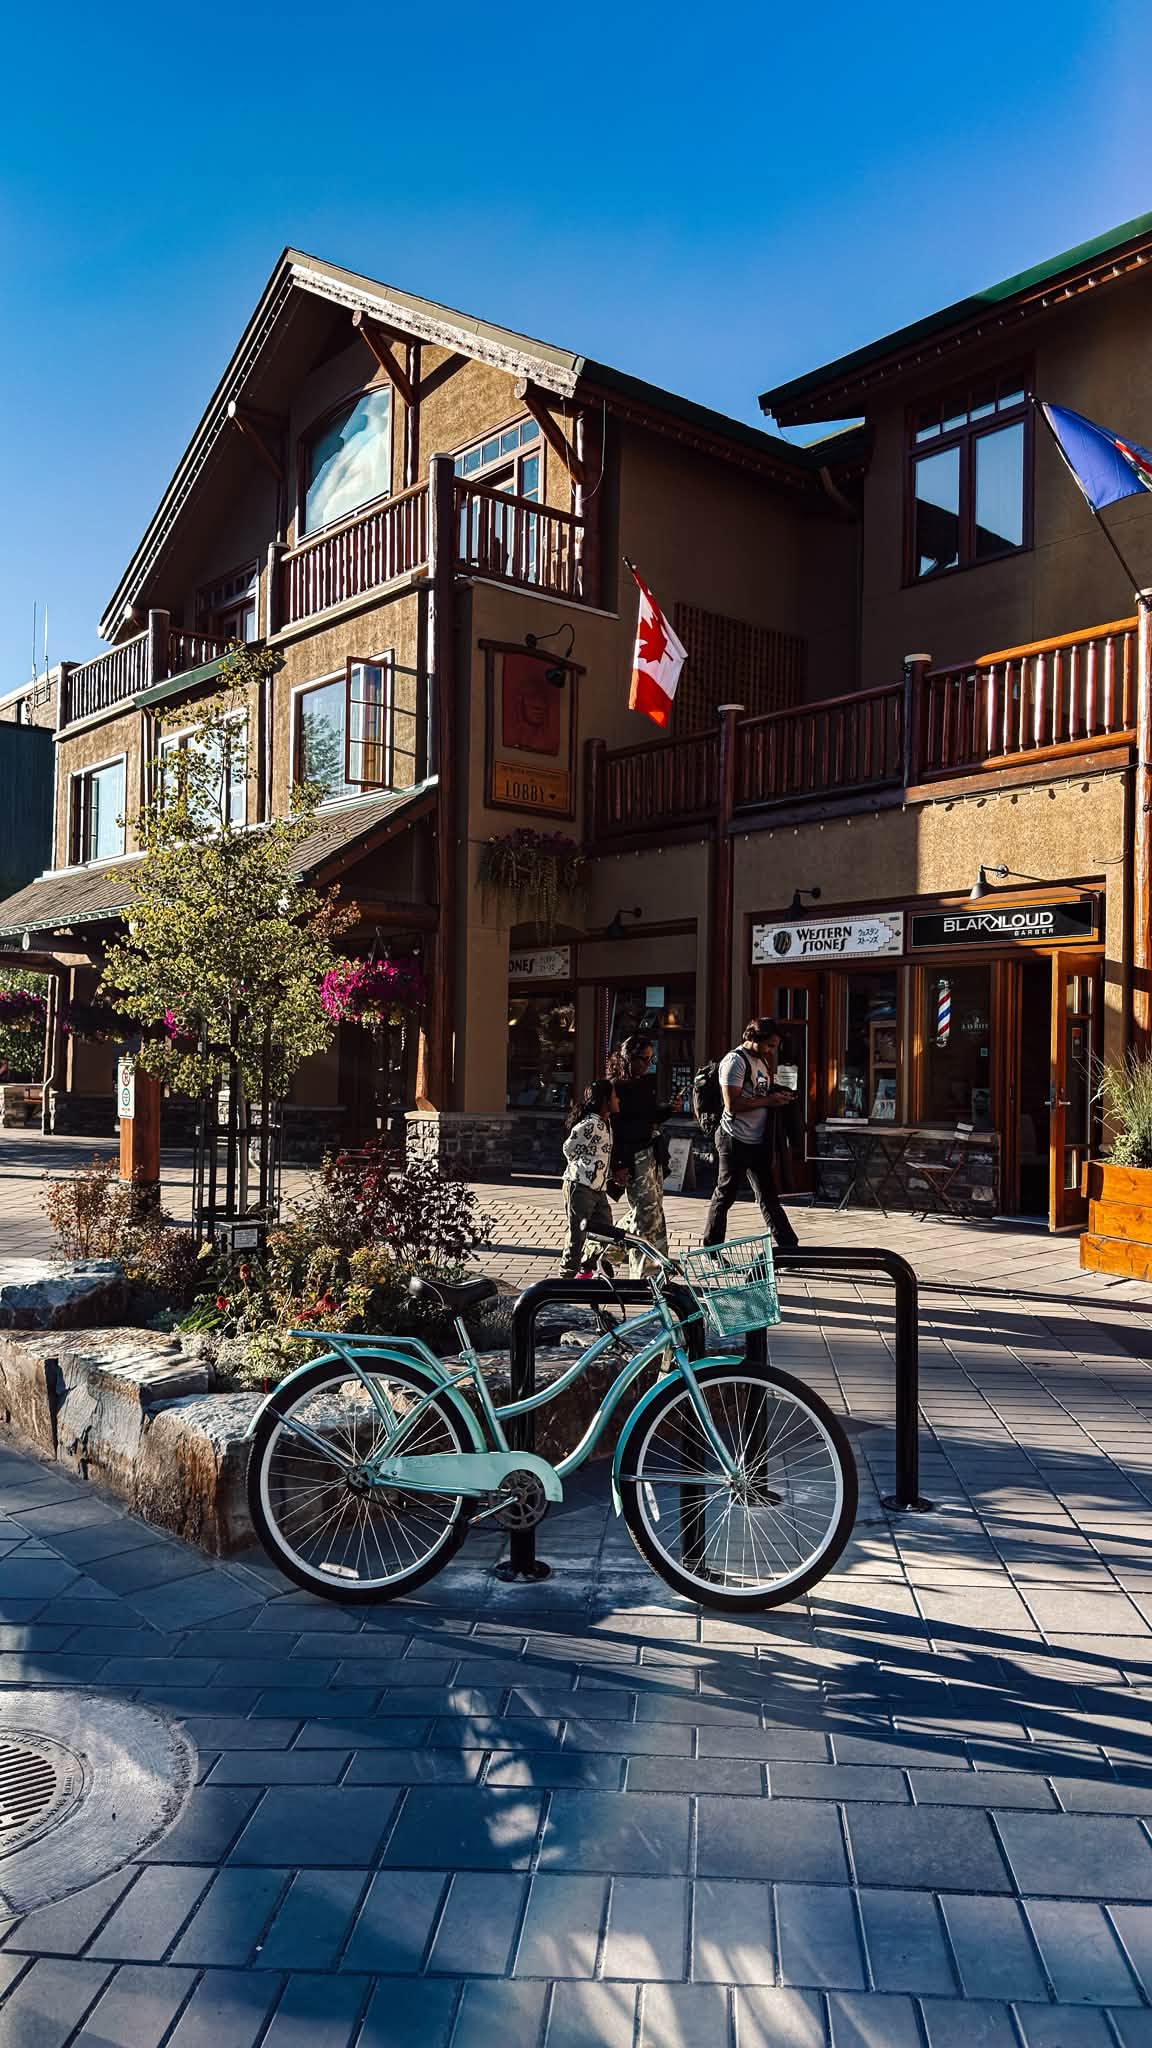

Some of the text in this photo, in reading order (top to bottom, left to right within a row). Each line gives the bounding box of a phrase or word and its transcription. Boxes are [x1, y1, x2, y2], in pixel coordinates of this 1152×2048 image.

[504, 779, 545, 802] LOBBY
[796, 926, 853, 941] WESTERN
[1014, 928, 1054, 937] BARBER
[800, 938, 848, 954] STONES
[508, 958, 537, 974] ONES
